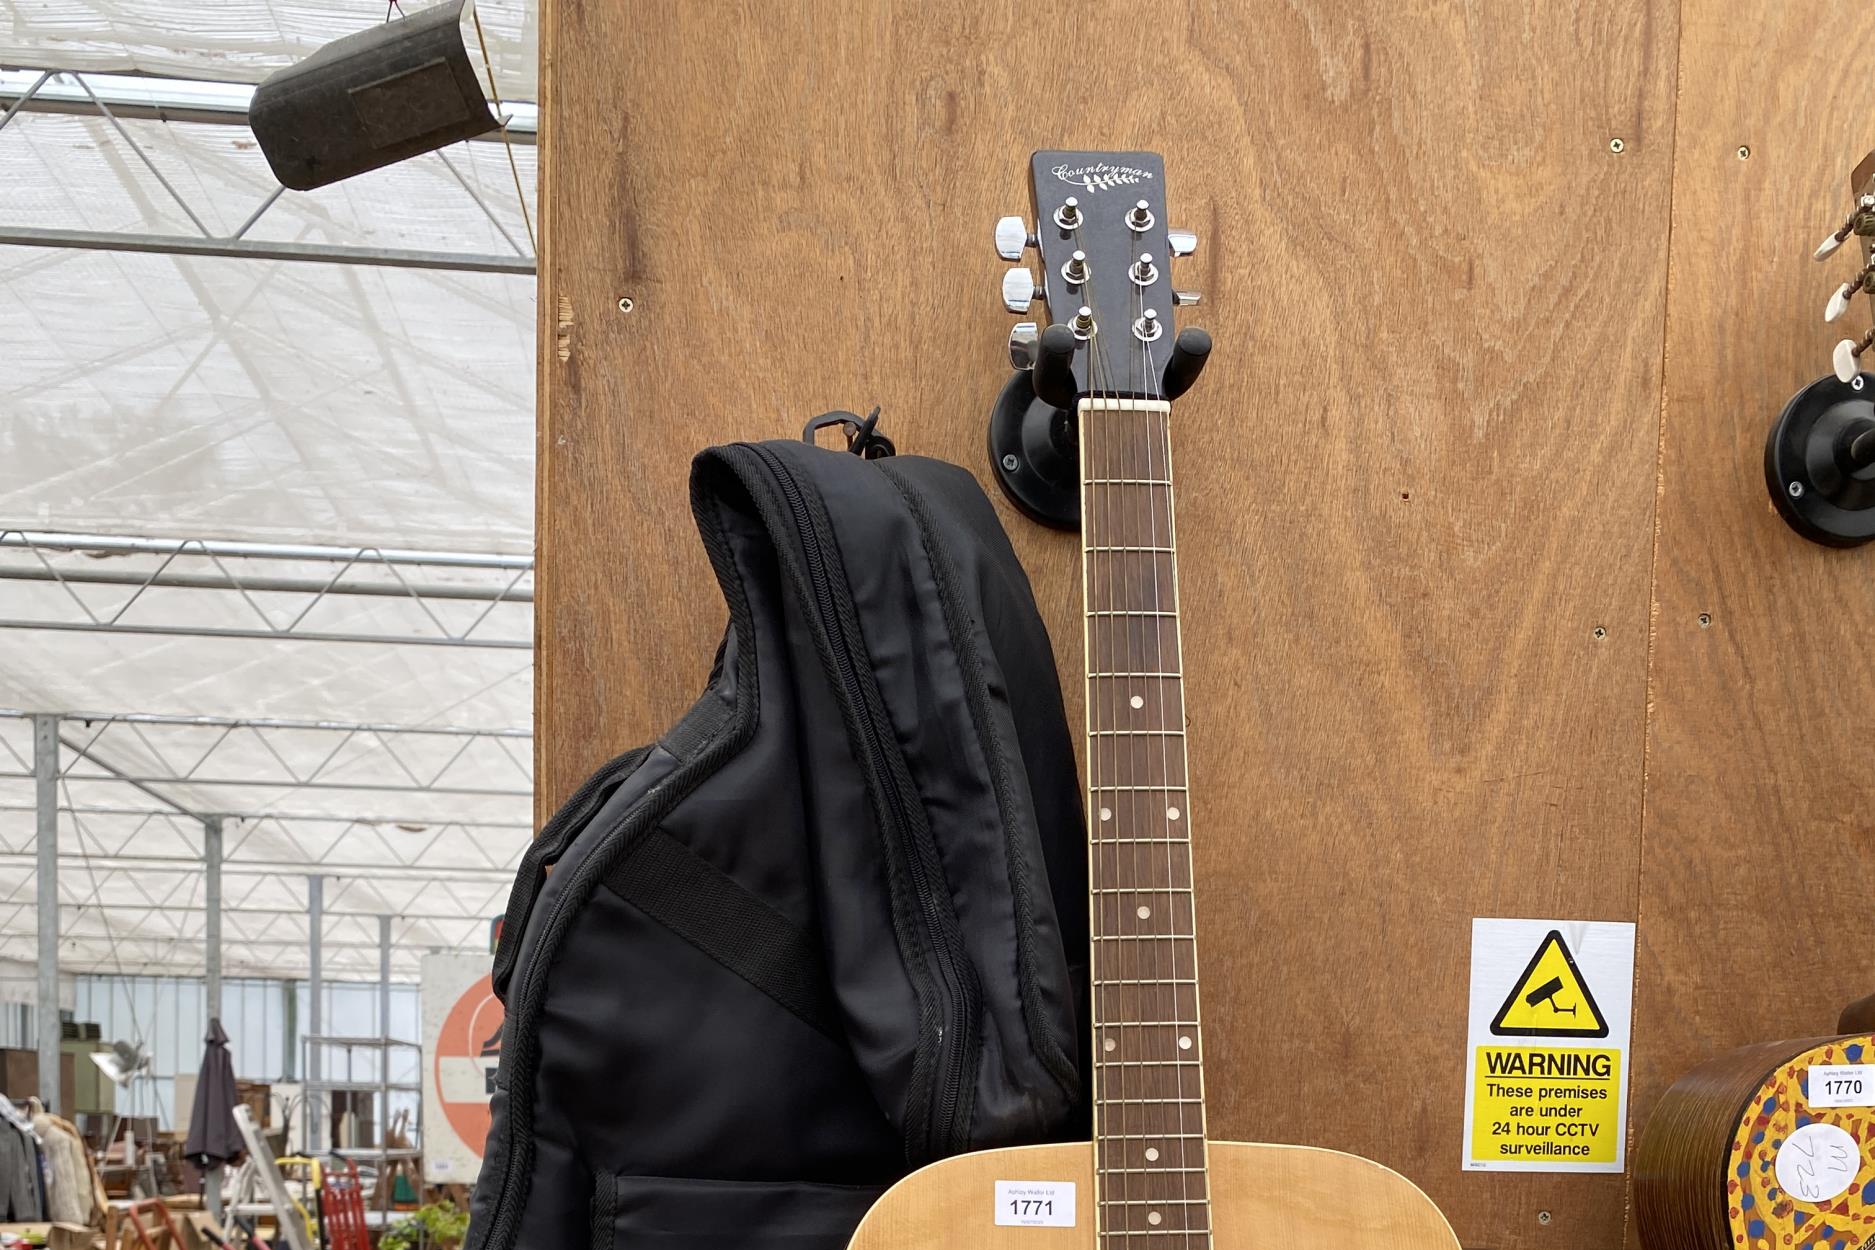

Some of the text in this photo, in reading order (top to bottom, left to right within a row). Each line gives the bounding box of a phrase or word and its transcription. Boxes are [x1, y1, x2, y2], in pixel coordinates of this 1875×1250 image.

[1051, 162, 1153, 181] Countryman
[1486, 1052, 1611, 1077] WARNING
[1486, 1084, 1607, 1101] These premises
[1825, 1080, 1862, 1095] 1770
[1509, 1105, 1582, 1117] are under
[1492, 1122, 1599, 1136] 24 hour CCTV
[1500, 1142, 1590, 1155] surveillance
[1010, 1200, 1052, 1215] 1771
